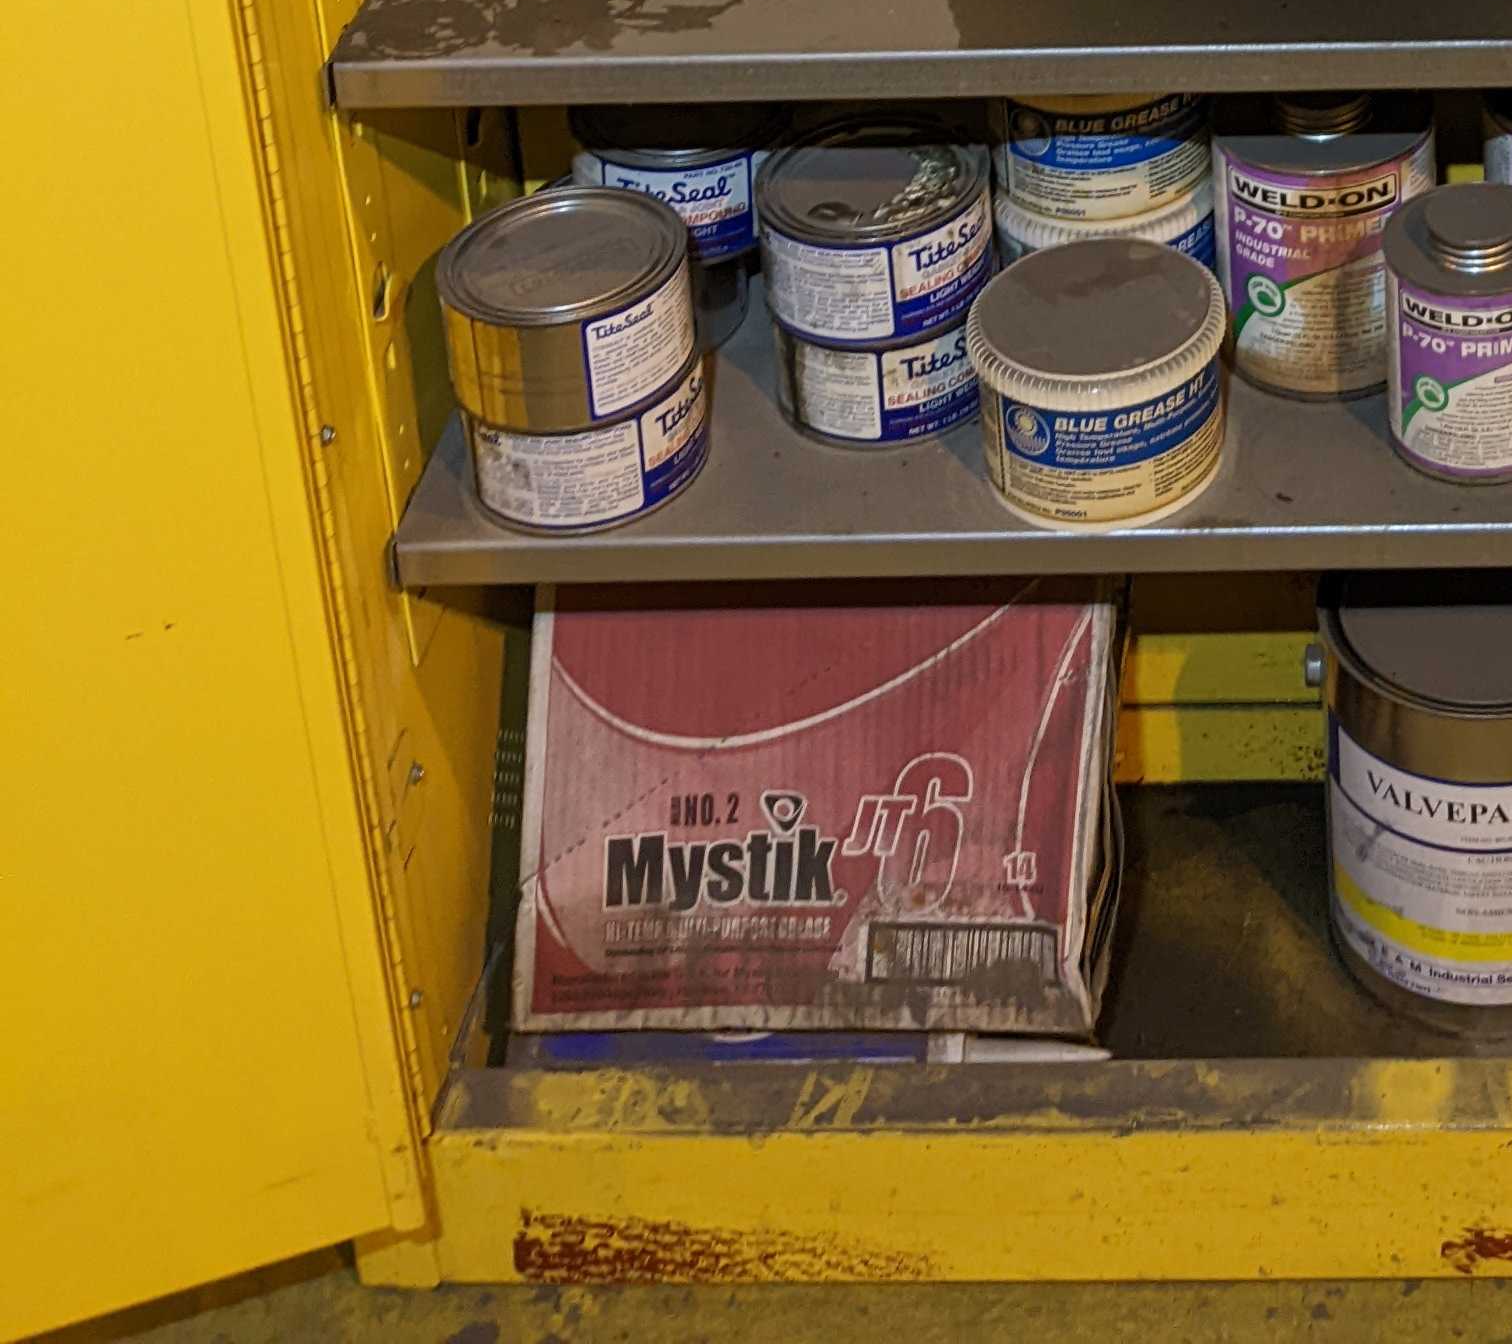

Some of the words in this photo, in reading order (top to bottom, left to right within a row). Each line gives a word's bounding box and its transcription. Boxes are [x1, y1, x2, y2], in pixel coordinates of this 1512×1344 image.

[1055, 120, 1105, 133] BLUE
[1111, 103, 1177, 130] GREASE
[1235, 230, 1312, 258] INDUSTRIAL
[1235, 245, 1275, 269] GRADE
[900, 337, 968, 382] TiteS
[887, 381, 947, 407] SEALING
[1054, 416, 1109, 433] BLUE
[1113, 388, 1187, 430] GREASE
[686, 796, 722, 827] NO.
[726, 793, 740, 824] 2
[605, 825, 837, 912] Mystik
[1428, 968, 1494, 985] Industrial
